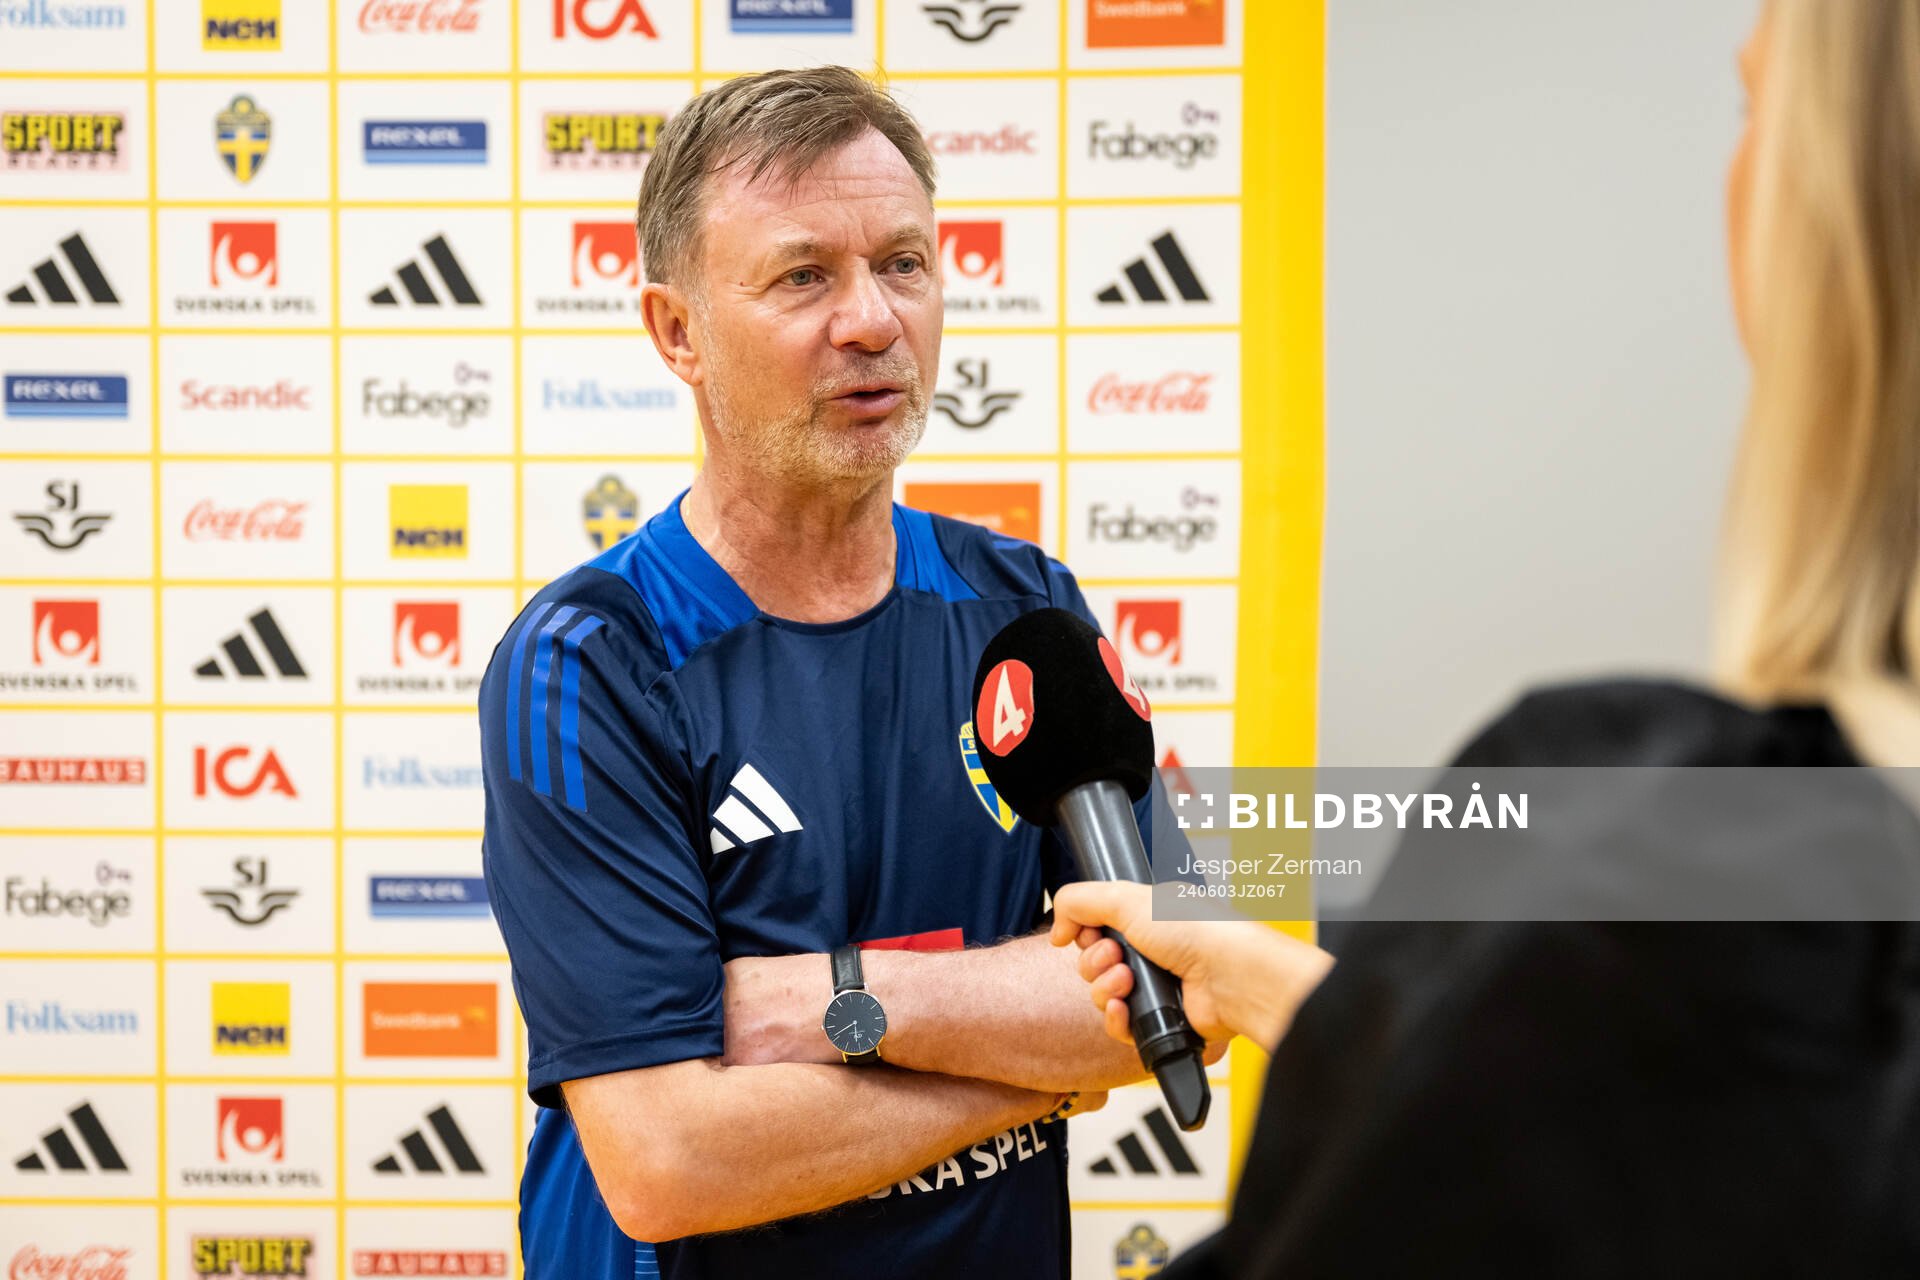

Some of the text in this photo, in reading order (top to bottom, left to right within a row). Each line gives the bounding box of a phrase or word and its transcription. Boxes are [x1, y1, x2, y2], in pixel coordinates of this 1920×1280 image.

[0, 0, 126, 27] olksam
[553, 0, 659, 40] ICA
[1, 113, 123, 153] SPORT
[545, 114, 666, 153] SPORT
[926, 126, 1037, 153] candic
[1089, 121, 1218, 169] Fabege
[180, 380, 311, 410] Scandic
[363, 378, 490, 427] Fabege
[542, 380, 677, 409] Folksam
[1089, 505, 1217, 552] Fabege
[993, 664, 1026, 747] 4
[195, 747, 298, 798] ICA
[5, 879, 130, 926] Fabege
[7, 1002, 137, 1033] Folksam
[969, 1122, 1047, 1180] SPEL
[194, 1237, 312, 1277] SPORT
